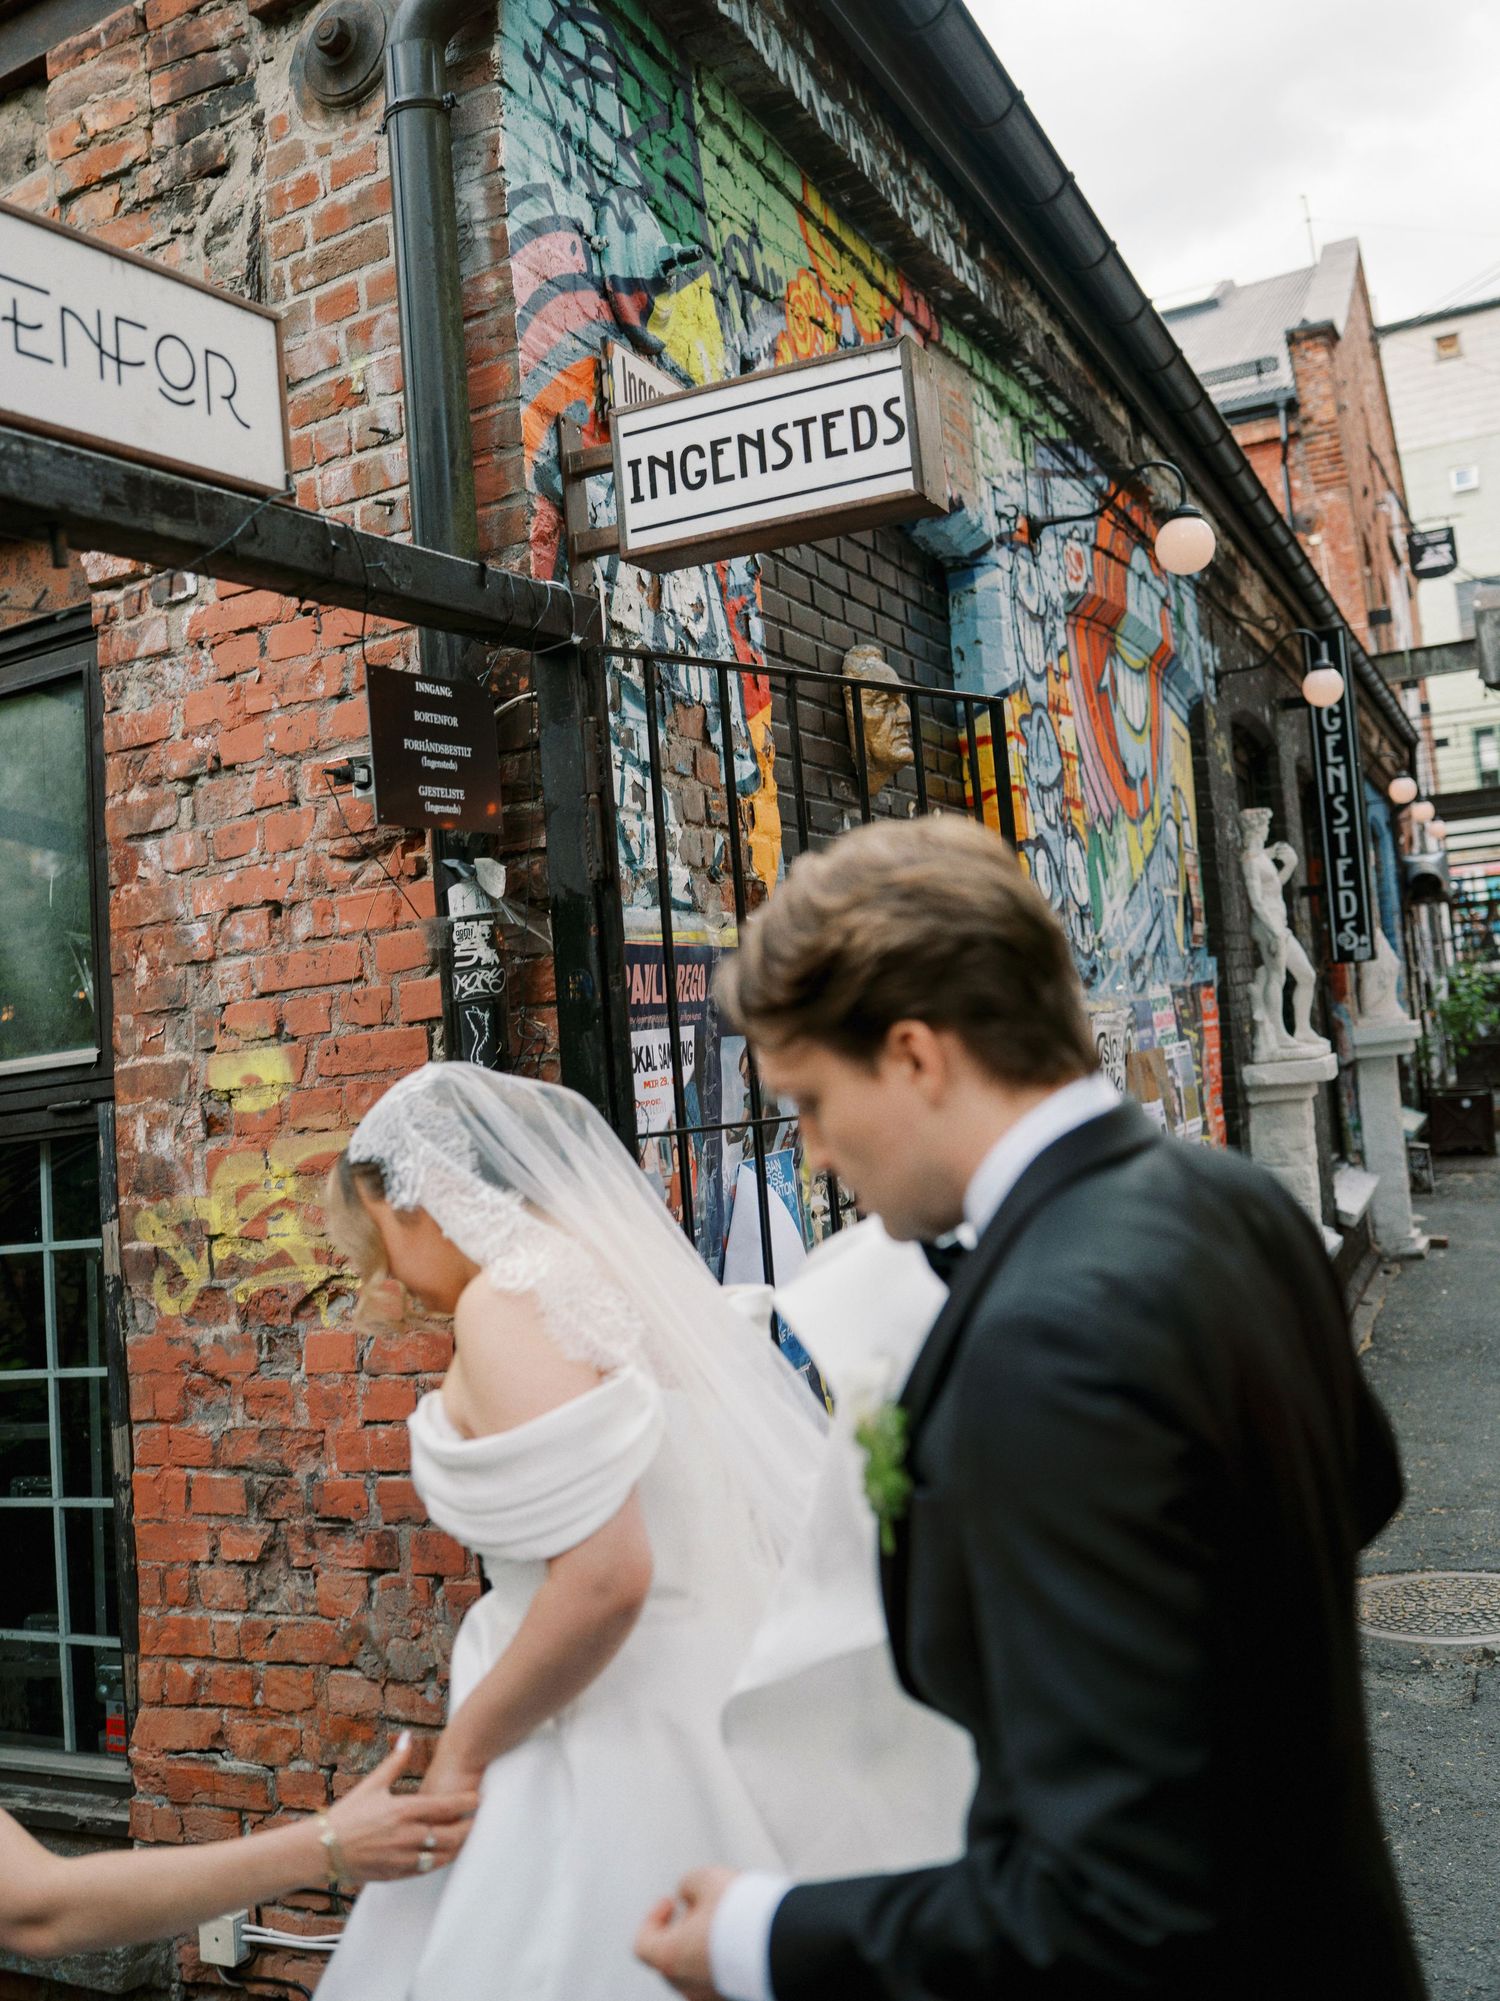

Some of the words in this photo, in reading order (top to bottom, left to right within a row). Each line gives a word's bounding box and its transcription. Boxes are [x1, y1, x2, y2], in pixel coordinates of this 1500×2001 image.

[0, 274, 251, 429] ENFOR
[626, 396, 906, 505] INGENSTEDS
[415, 681, 453, 697] INNGANG:
[413, 710, 459, 727] BORTENFOR
[403, 739, 472, 758] FORHÅNDSBESTILT
[421, 756, 458, 773] (Ingensteds)
[418, 785, 466, 801] GJESTELISTE
[424, 801, 462, 817] (Ingensteds)
[1321, 704, 1358, 951] GENSTEDS
[676, 963, 706, 1003] REGO
[632, 1044, 658, 1073] OKAL
[766, 1159, 782, 1174] BAN
